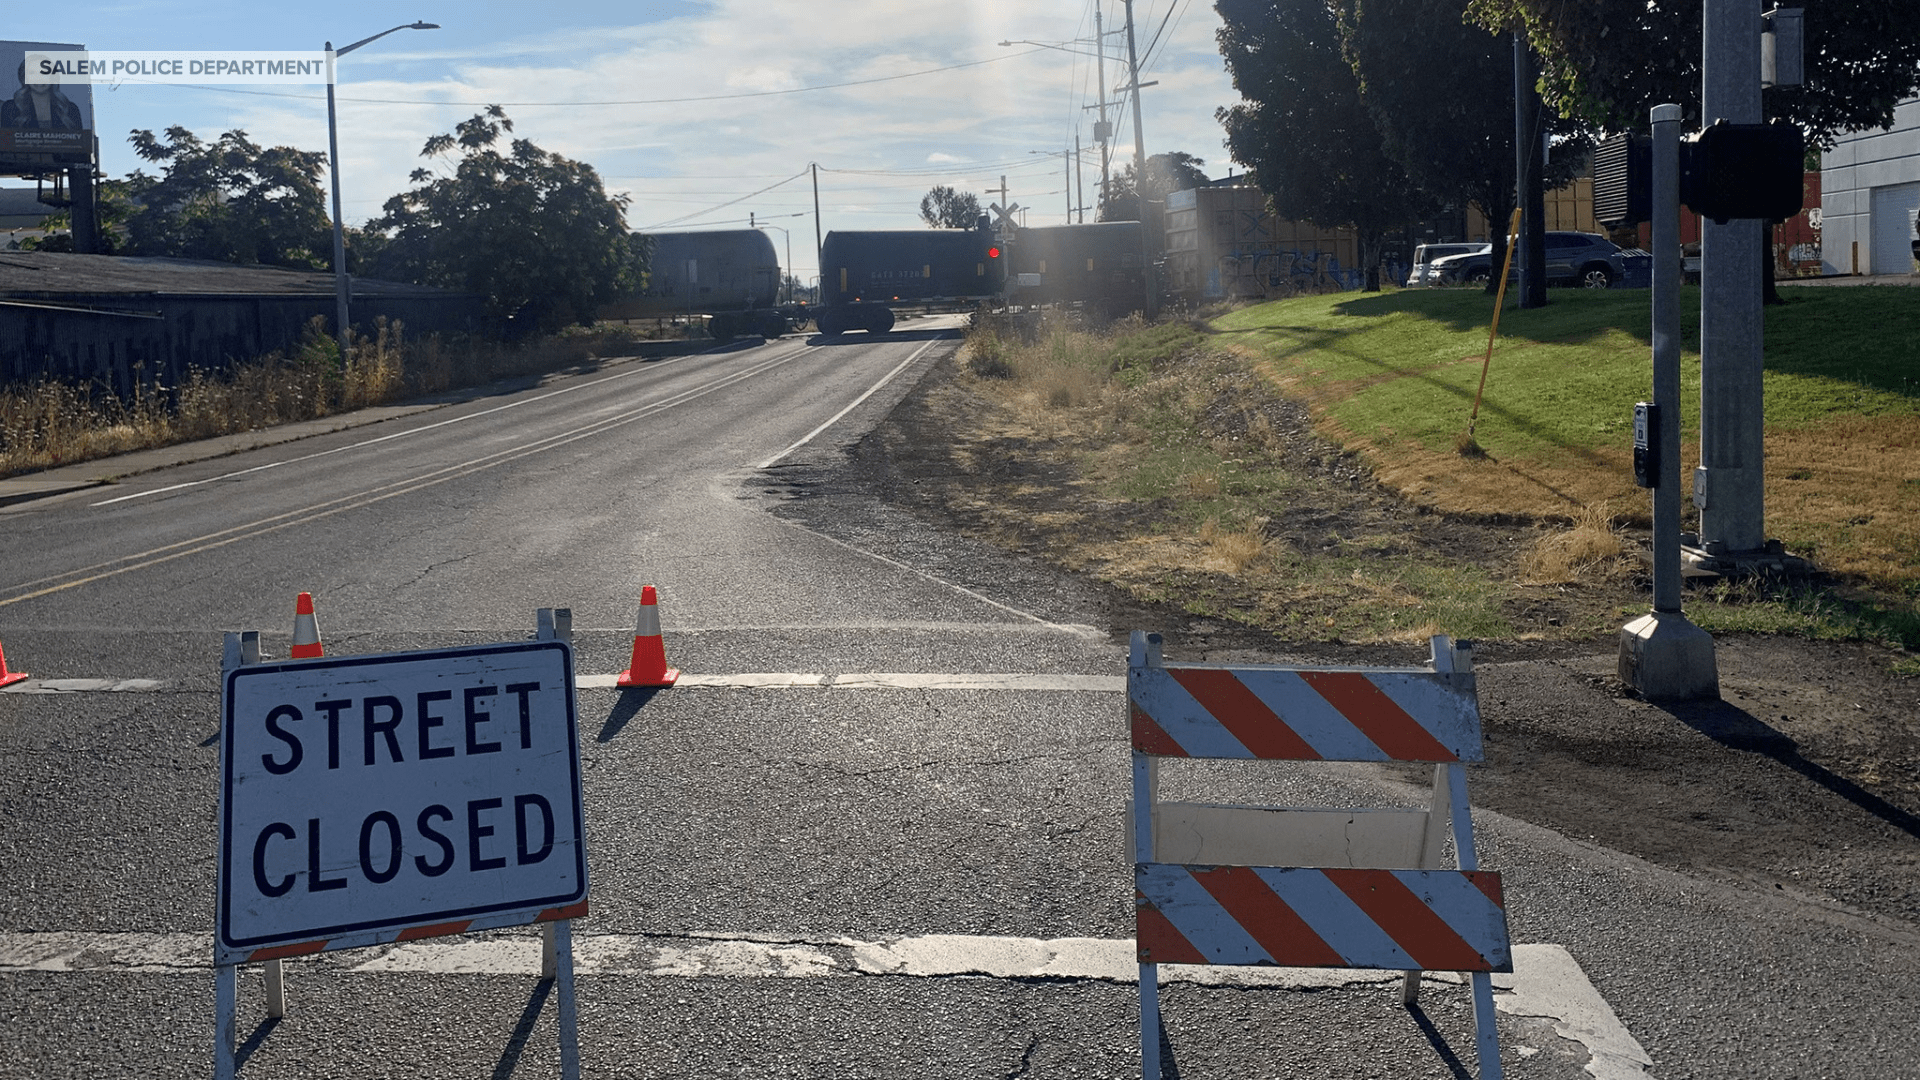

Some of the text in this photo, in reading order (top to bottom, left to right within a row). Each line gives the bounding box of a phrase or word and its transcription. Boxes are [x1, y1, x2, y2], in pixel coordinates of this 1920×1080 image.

[43, 132, 82, 140] MAHONEY
[261, 681, 541, 776] STREET
[252, 793, 556, 899] CLOSED
